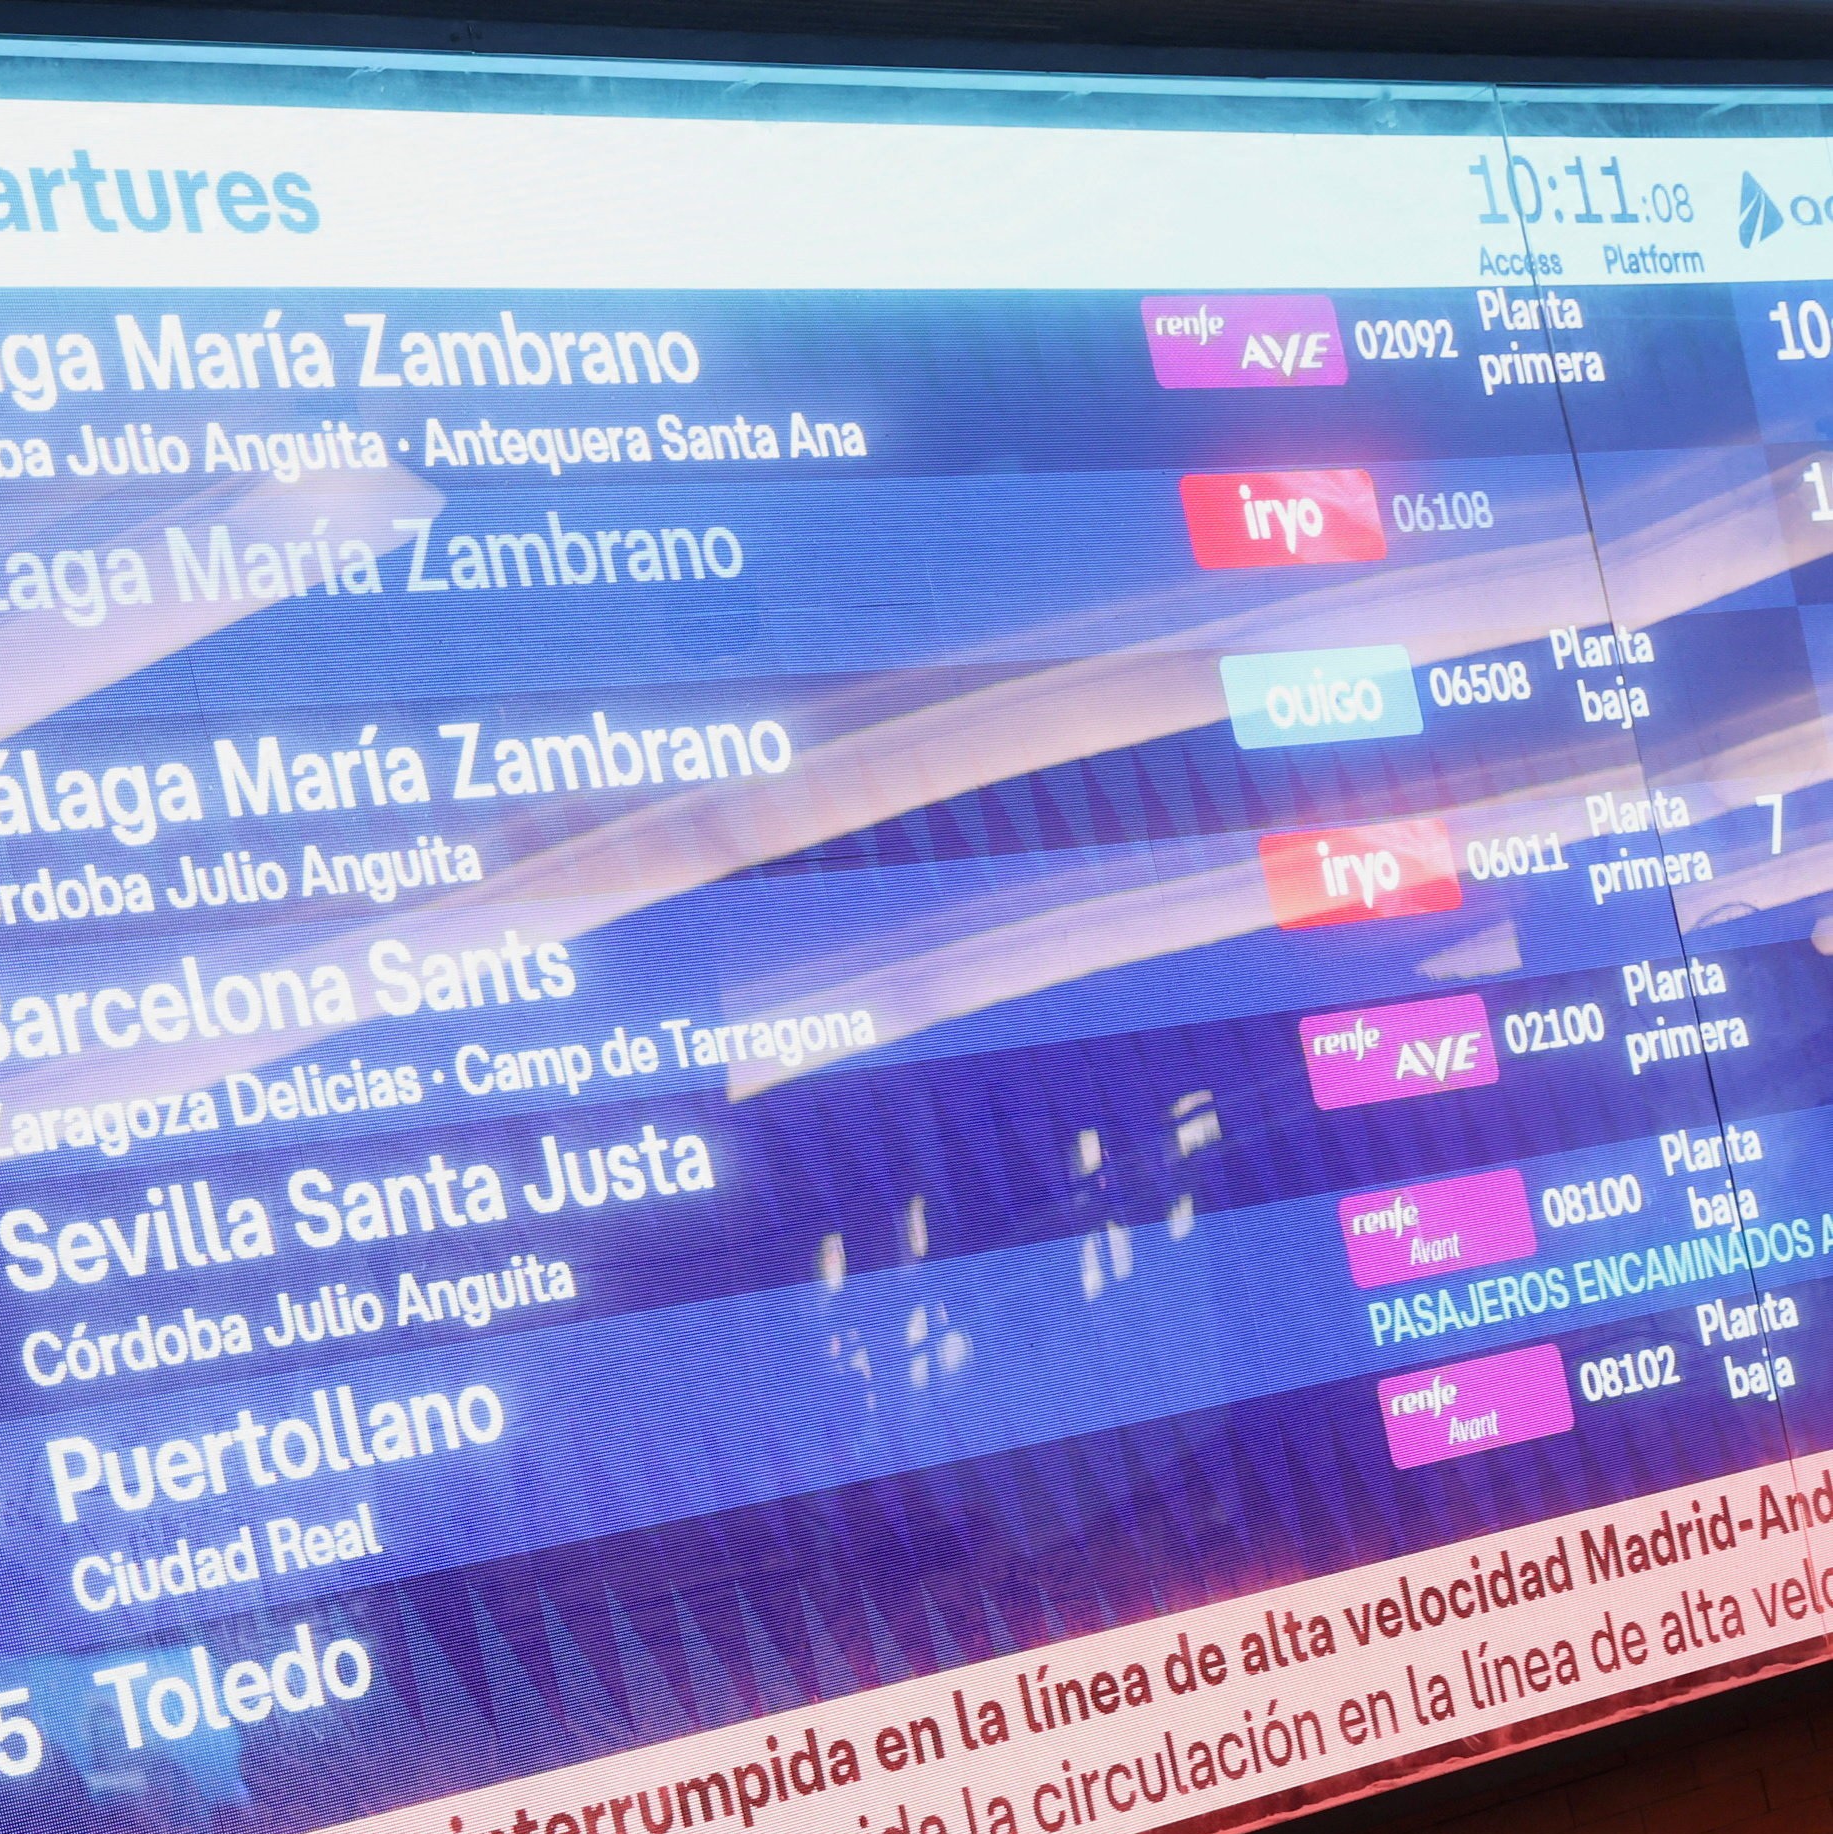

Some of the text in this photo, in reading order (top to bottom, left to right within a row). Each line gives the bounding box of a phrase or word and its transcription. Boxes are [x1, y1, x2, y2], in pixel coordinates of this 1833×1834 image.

[1479, 244, 1564, 277] Access
[1605, 243, 1705, 275] Platform
[1155, 304, 1224, 345] renfe
[1476, 289, 1583, 332] Planta
[116, 310, 334, 392] María
[345, 311, 699, 389] Zambrano
[1241, 331, 1331, 376] AVE
[1355, 318, 1459, 360] 02092
[1478, 342, 1605, 395] primera
[66, 423, 189, 477] Julio
[205, 419, 388, 483] Anguita
[424, 417, 652, 475] Antequera
[661, 412, 780, 460] Santa
[790, 411, 867, 457] Ana
[1239, 485, 1323, 554] iryo
[1392, 490, 1493, 535] 06108
[164, 517, 382, 601] María
[393, 512, 743, 592] Zambrano
[1550, 626, 1654, 671] Planta
[1429, 661, 1531, 707] 06508
[1577, 678, 1650, 729] baja
[215, 725, 430, 818] María
[438, 711, 794, 801] Zambrano
[1586, 790, 1690, 837] Planta
[1756, 794, 1783, 855] 7
[166, 851, 289, 909] Julio
[302, 835, 482, 905] Anguita
[1317, 840, 1400, 908] iryo
[1467, 832, 1569, 882] 06011
[1589, 848, 1713, 904] primera
[368, 929, 578, 1017] Sants
[1623, 957, 1727, 1007] Planta
[1313, 1019, 1380, 1061] renfe
[1505, 1003, 1605, 1054] 02100
[1626, 1015, 1750, 1075] primera
[226, 1059, 424, 1127] Delicias
[456, 1040, 592, 1096] Camp
[604, 1027, 659, 1081] de
[662, 1008, 877, 1068] Tarragona
[1396, 1032, 1481, 1082] AVE
[1660, 1126, 1763, 1177] Planta
[0, 1124, 716, 1293] Sevilla Santa Justa
[1352, 1196, 1420, 1238] renfe
[1543, 1174, 1642, 1228] 08100
[1687, 1178, 1759, 1233] baja
[1410, 1233, 1460, 1267] Avant
[1368, 1267, 1570, 1347] PASAJEROS
[1576, 1218, 1815, 1307] ENCAMINADOS
[21, 1255, 575, 1388] Córdoba Julio Anguita
[1696, 1292, 1799, 1346] Planta
[1391, 1374, 1458, 1417] renfe
[1580, 1345, 1681, 1402] 08102
[1725, 1351, 1796, 1402] baja
[45, 1382, 505, 1525] Puertollano
[1448, 1410, 1499, 1445] Avant
[72, 1504, 384, 1614] Ciudad Real
[875, 1716, 945, 1773] en
[952, 1690, 1009, 1751] la
[1018, 1664, 1153, 1734] línea
[1165, 1632, 1228, 1695] de
[1240, 1610, 1334, 1676] alta
[1344, 1537, 1573, 1648] velocidad
[93, 1622, 372, 1753] Toledo
[1032, 1699, 1326, 1834] circulación
[1338, 1689, 1400, 1746] en
[1406, 1664, 1456, 1726] la
[1462, 1641, 1580, 1711] línea
[1590, 1611, 1649, 1674] de
[1660, 1589, 1745, 1656] alta
